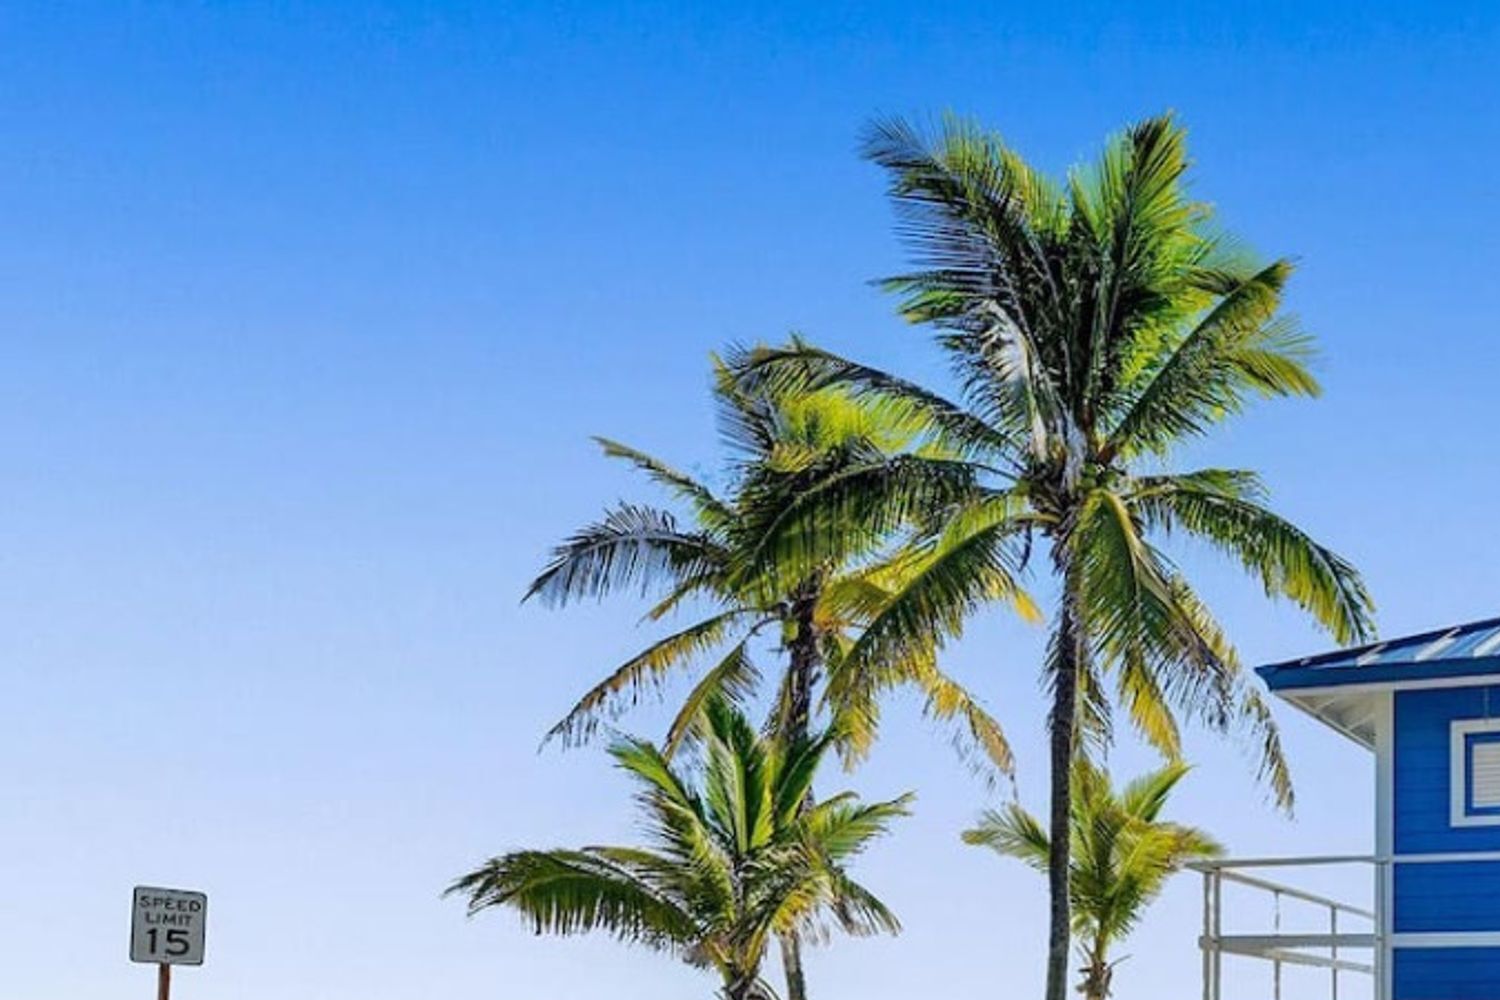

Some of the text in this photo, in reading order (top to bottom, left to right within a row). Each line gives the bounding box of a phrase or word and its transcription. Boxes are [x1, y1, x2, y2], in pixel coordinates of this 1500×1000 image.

[139, 895, 202, 912] SPEED
[145, 911, 192, 927] LIMIT
[146, 928, 190, 956] 15
